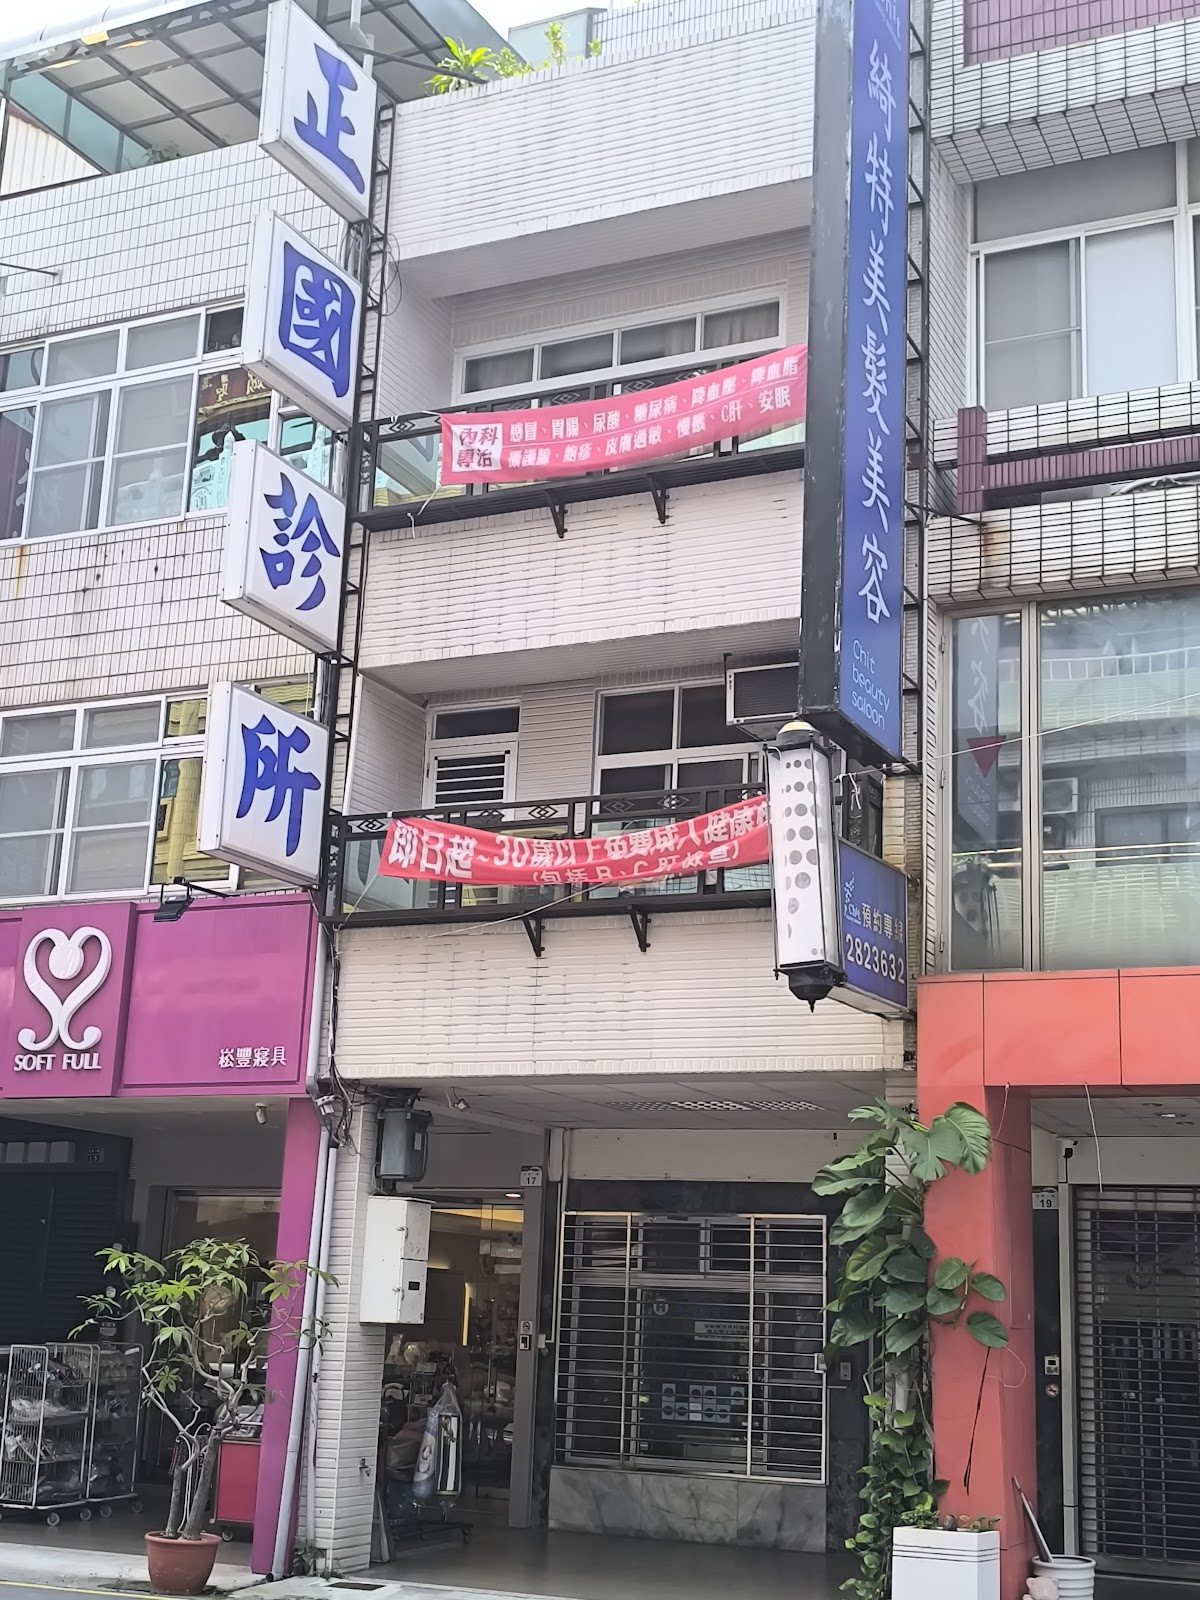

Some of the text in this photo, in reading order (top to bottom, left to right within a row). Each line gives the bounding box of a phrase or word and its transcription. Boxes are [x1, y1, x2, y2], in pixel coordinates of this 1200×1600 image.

[237, 42, 365, 858] 正國診所
[458, 426, 499, 447] 內科
[456, 447, 494, 469] 專治
[852, 640, 876, 674] Chit
[852, 663, 890, 712] beauty
[851, 690, 885, 731] saloon
[845, 933, 905, 984] 2823632
[13, 1053, 102, 1071] SOFT FULL
[527, 1176, 537, 1185] 17
[1039, 1198, 1052, 1208] 19
